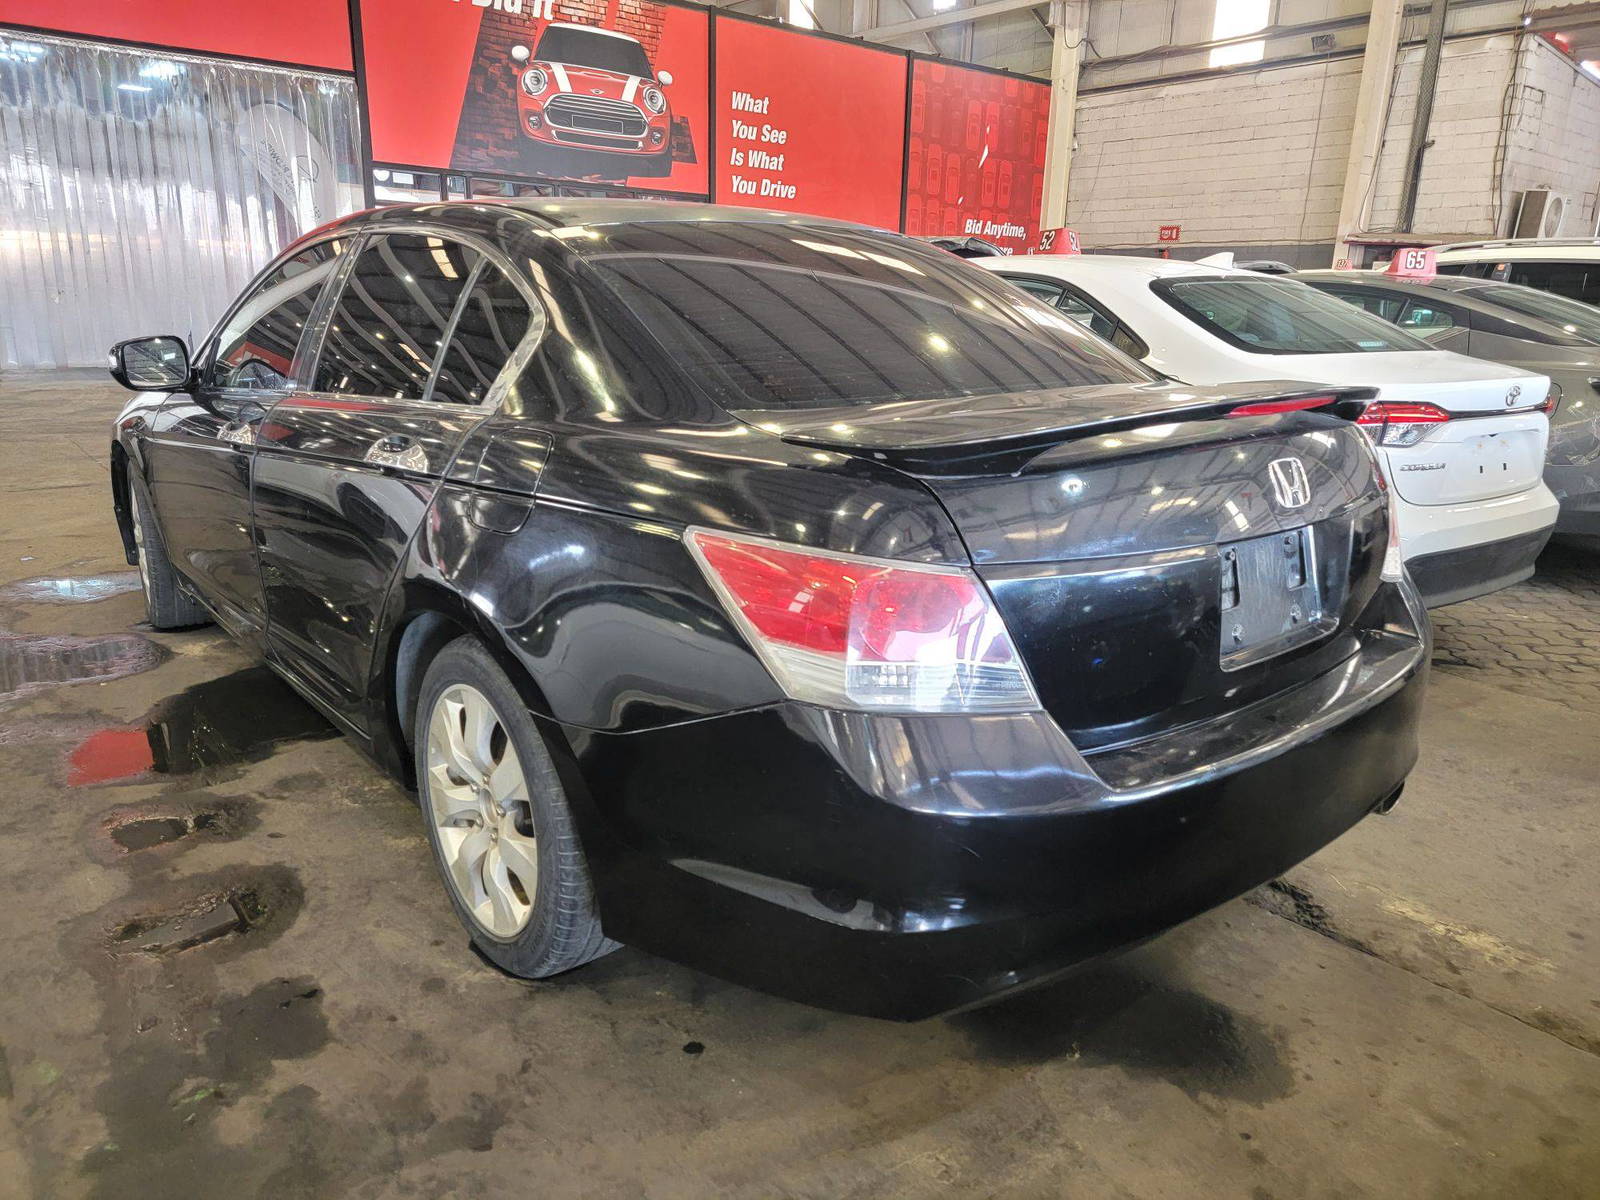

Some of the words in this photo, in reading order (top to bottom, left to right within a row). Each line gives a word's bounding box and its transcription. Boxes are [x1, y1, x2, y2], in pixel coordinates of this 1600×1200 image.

[731, 91, 769, 115] What
[732, 119, 758, 141] You
[761, 124, 787, 145] See
[730, 147, 745, 167] Is
[748, 149, 784, 172] What
[732, 175, 757, 195] You
[760, 178, 797, 200] Drive
[964, 218, 982, 235] Bid
[983, 220, 1027, 241] Anytime,
[1039, 230, 1056, 251] 52
[1406, 250, 1425, 269] 65
